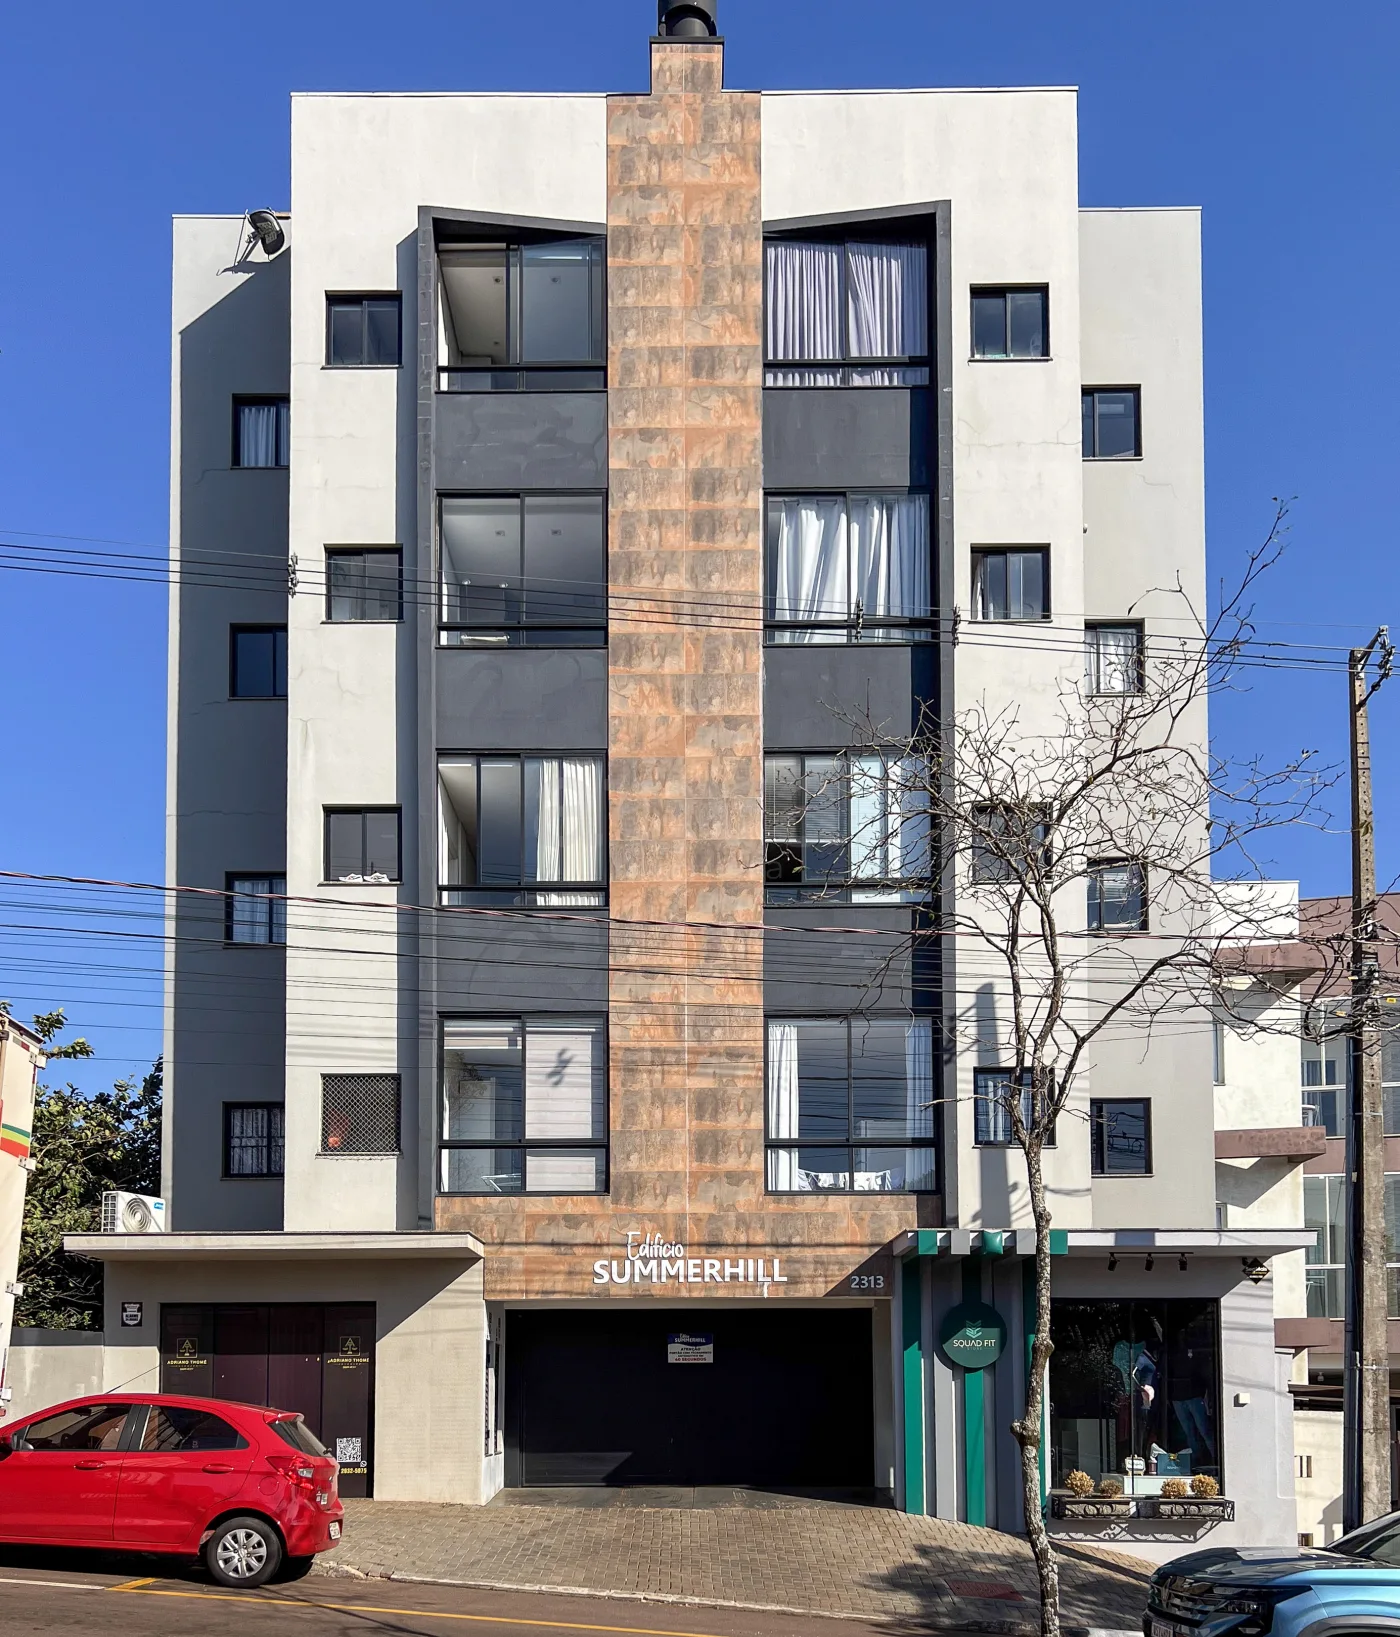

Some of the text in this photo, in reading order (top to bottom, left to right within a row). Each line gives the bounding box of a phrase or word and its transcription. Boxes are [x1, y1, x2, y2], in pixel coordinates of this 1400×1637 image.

[592, 1259, 788, 1283] SUMMERHILL
[850, 1275, 884, 1289] 2313
[953, 1339, 996, 1348] SQUAD FIT
